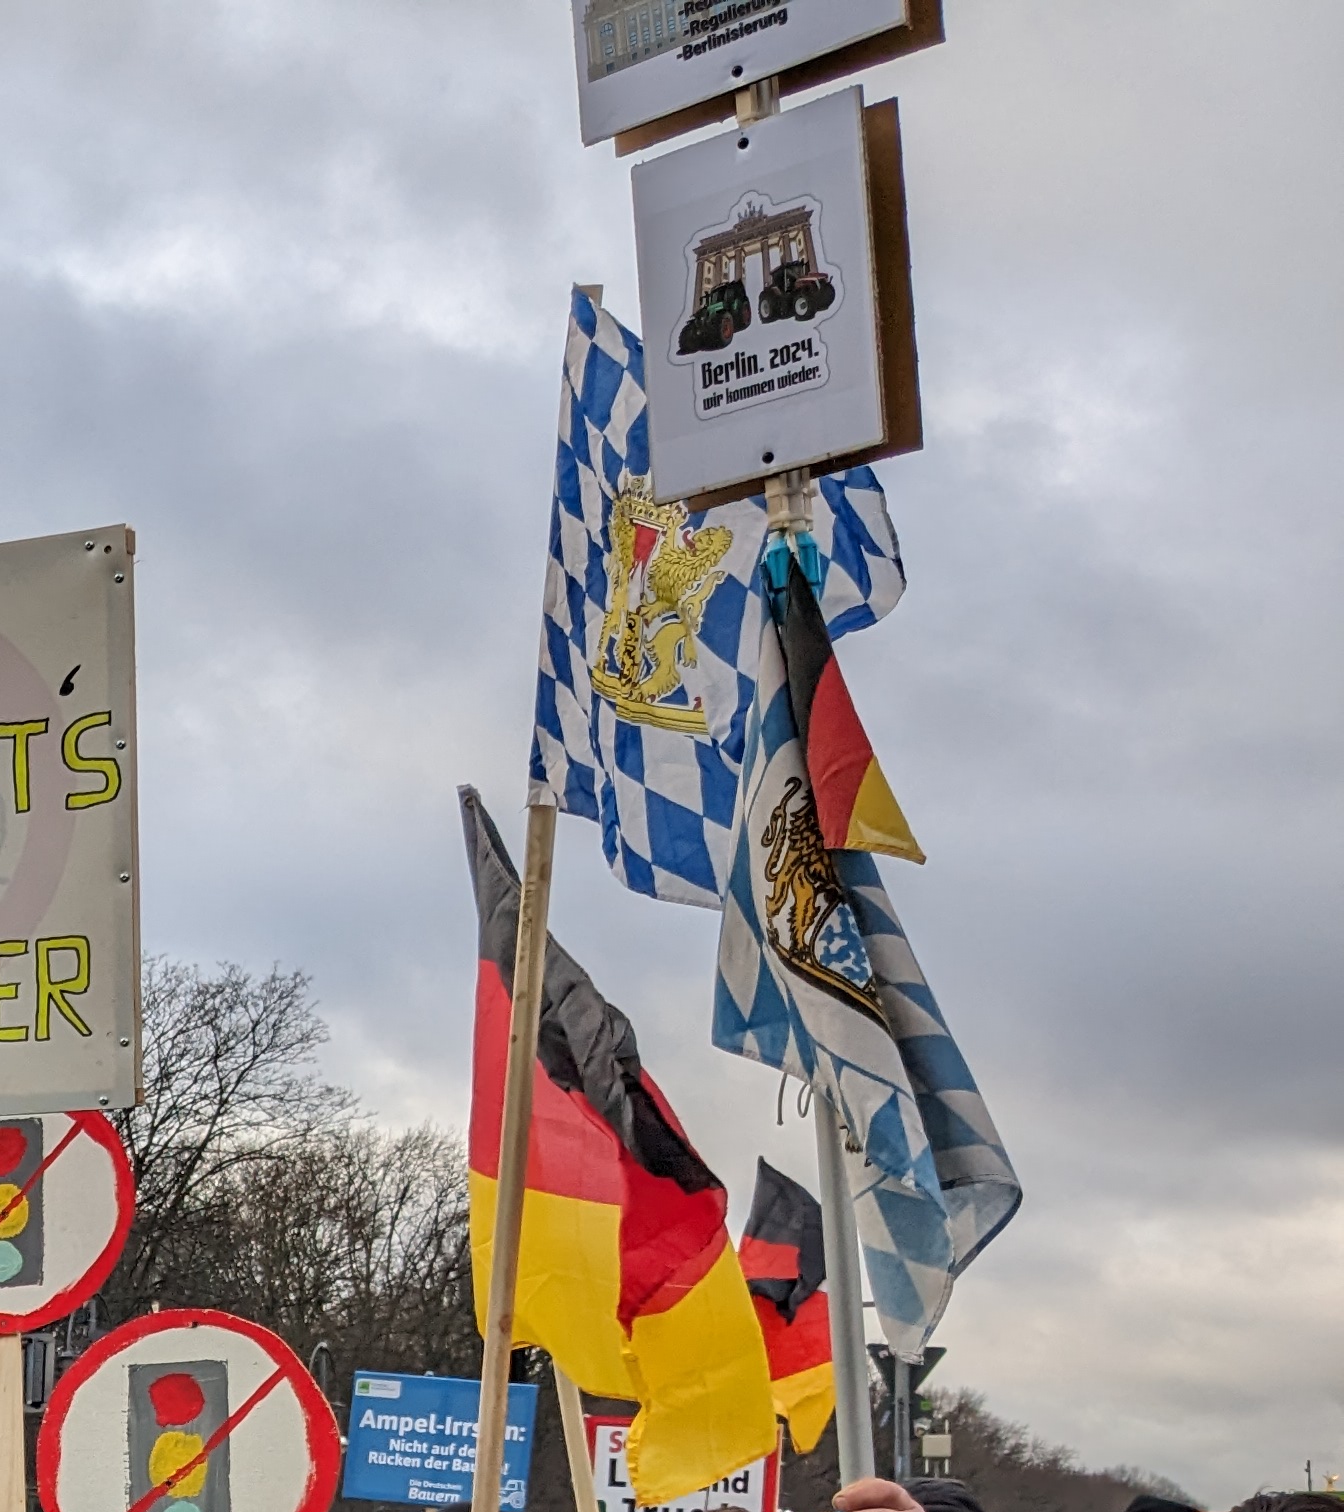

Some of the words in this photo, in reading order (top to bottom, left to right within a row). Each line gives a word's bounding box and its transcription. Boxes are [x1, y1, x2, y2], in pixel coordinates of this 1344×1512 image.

[677, 8, 787, 60] -Berlinisierung
[701, 351, 764, 390] Berlin.
[769, 337, 819, 371] 2024.
[702, 394, 724, 411] wir
[725, 379, 776, 404] kommen
[777, 365, 822, 392] wieder.
[359, 1409, 527, 1442] Ampel-Irrsn:
[368, 1451, 421, 1469] Rücken
[424, 1457, 449, 1472] der
[389, 1438, 428, 1454] Nicht
[431, 1443, 455, 1457] auf
[458, 1444, 476, 1458] de
[408, 1487, 461, 1504] Bauern
[409, 1478, 422, 1488] Die
[423, 1479, 462, 1491] Deutschen
